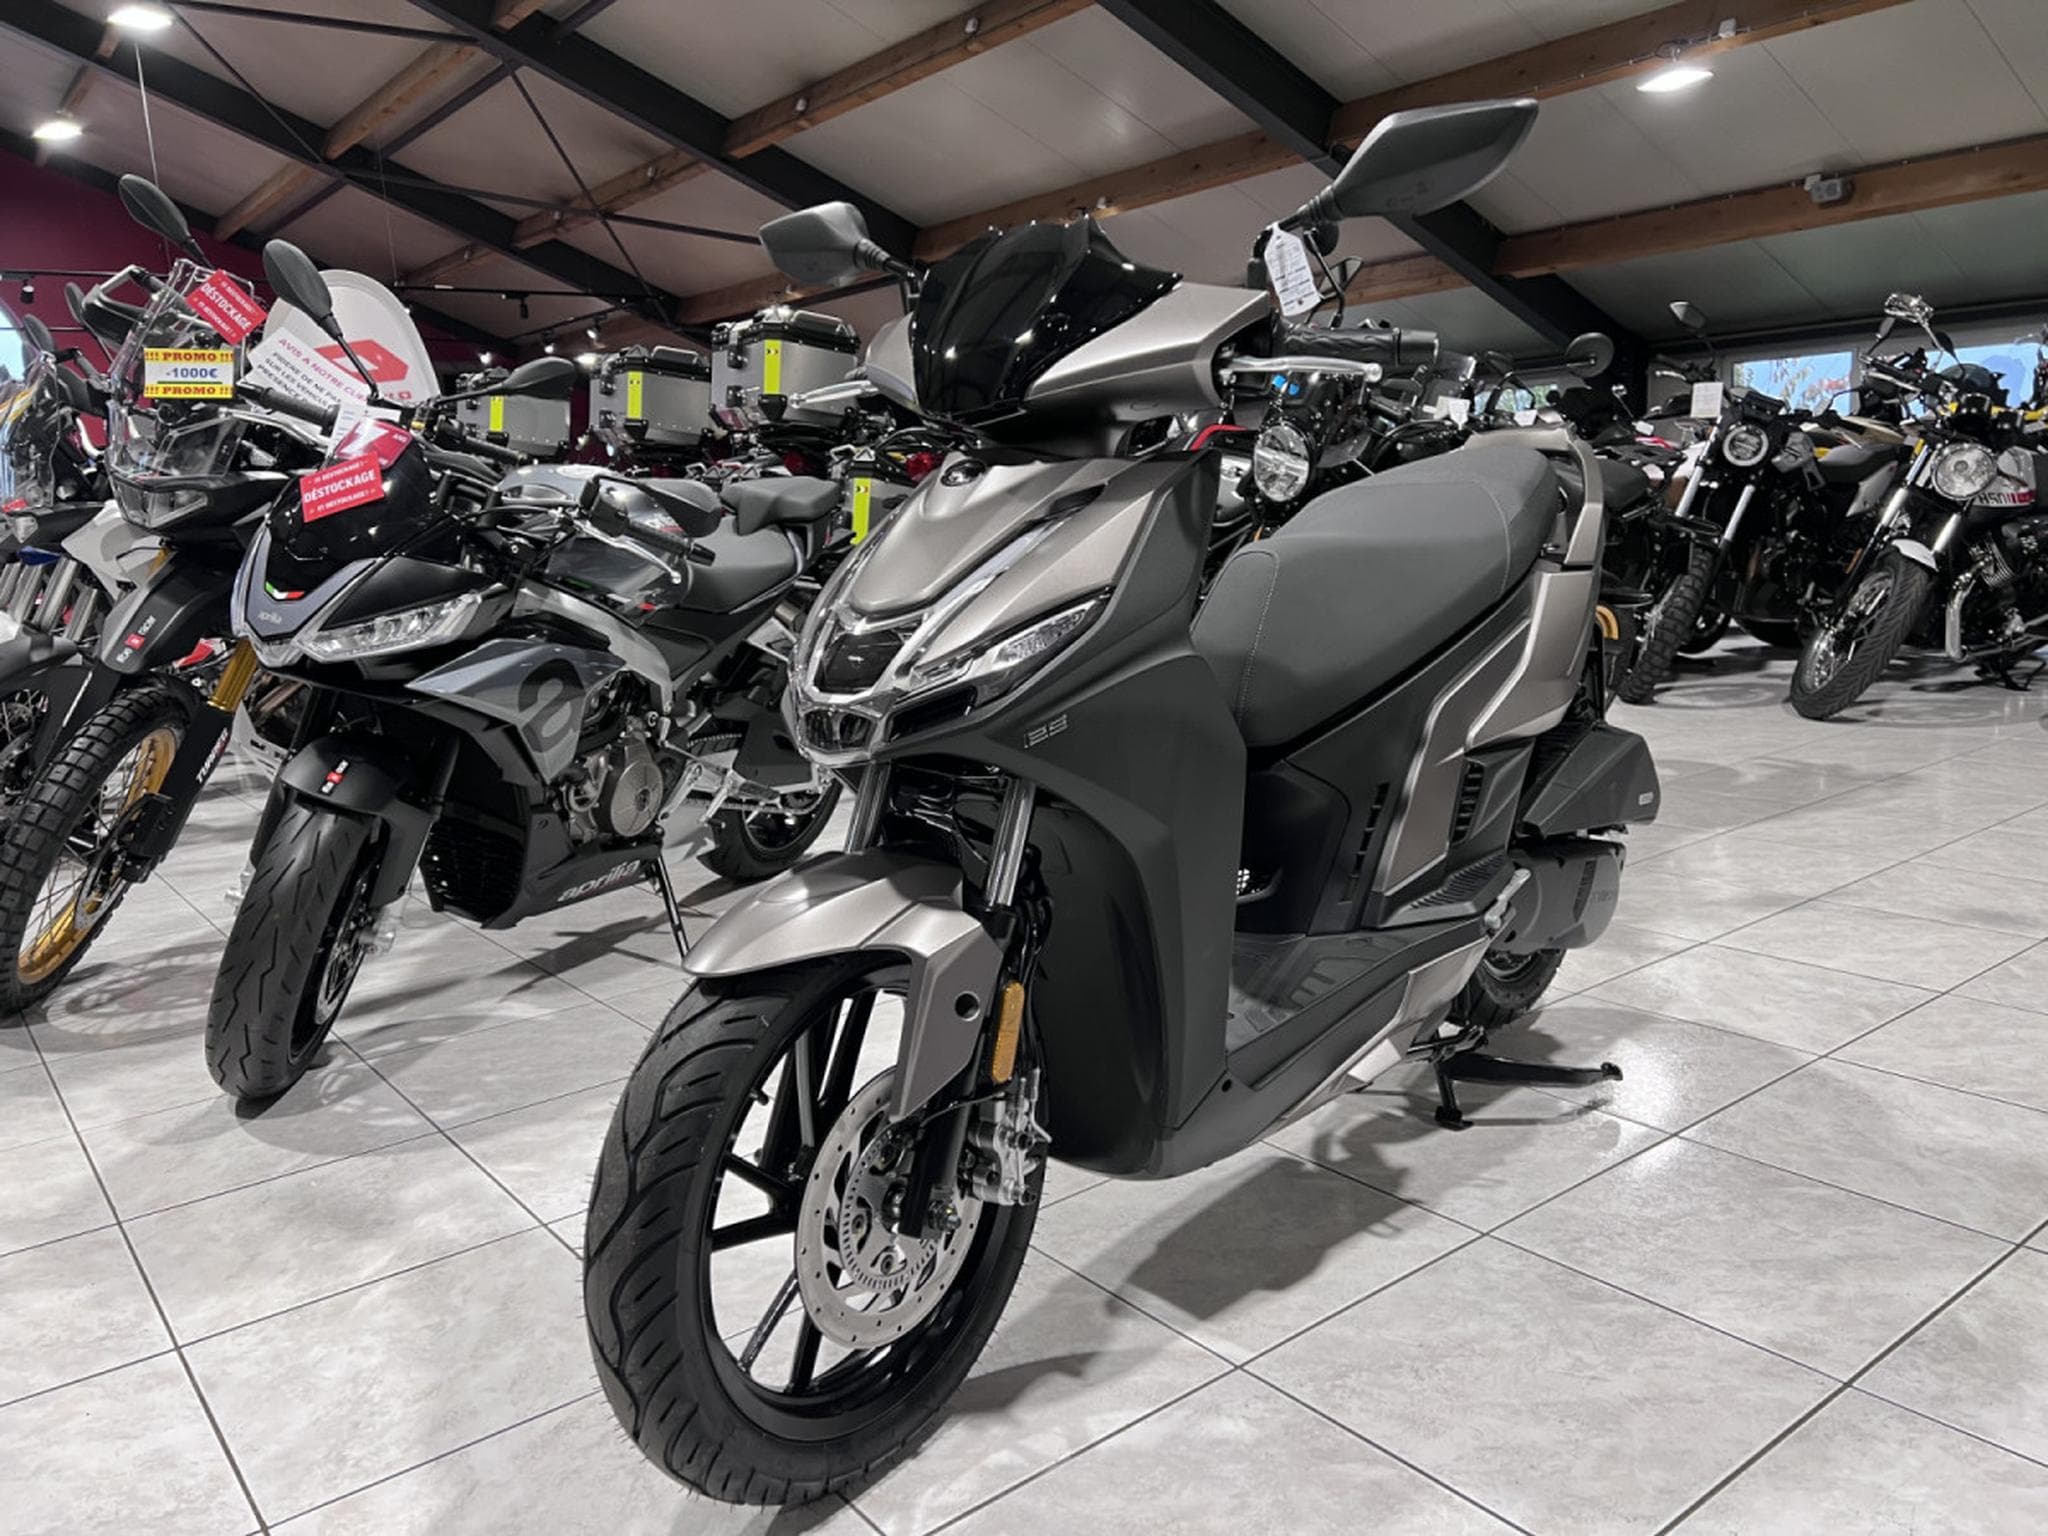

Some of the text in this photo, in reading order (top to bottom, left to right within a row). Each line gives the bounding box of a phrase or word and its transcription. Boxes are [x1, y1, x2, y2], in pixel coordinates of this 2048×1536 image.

[200, 281, 253, 330] DÉSTOCKAGE
[163, 352, 217, 361] PROMO
[278, 338, 302, 358] AVIS
[302, 357, 311, 366] A
[311, 362, 344, 388] NOTRE
[166, 367, 218, 378] -1000€
[300, 373, 313, 385] DE
[163, 386, 216, 395] PROMO
[302, 468, 375, 503] DÉSTOCKAGE
